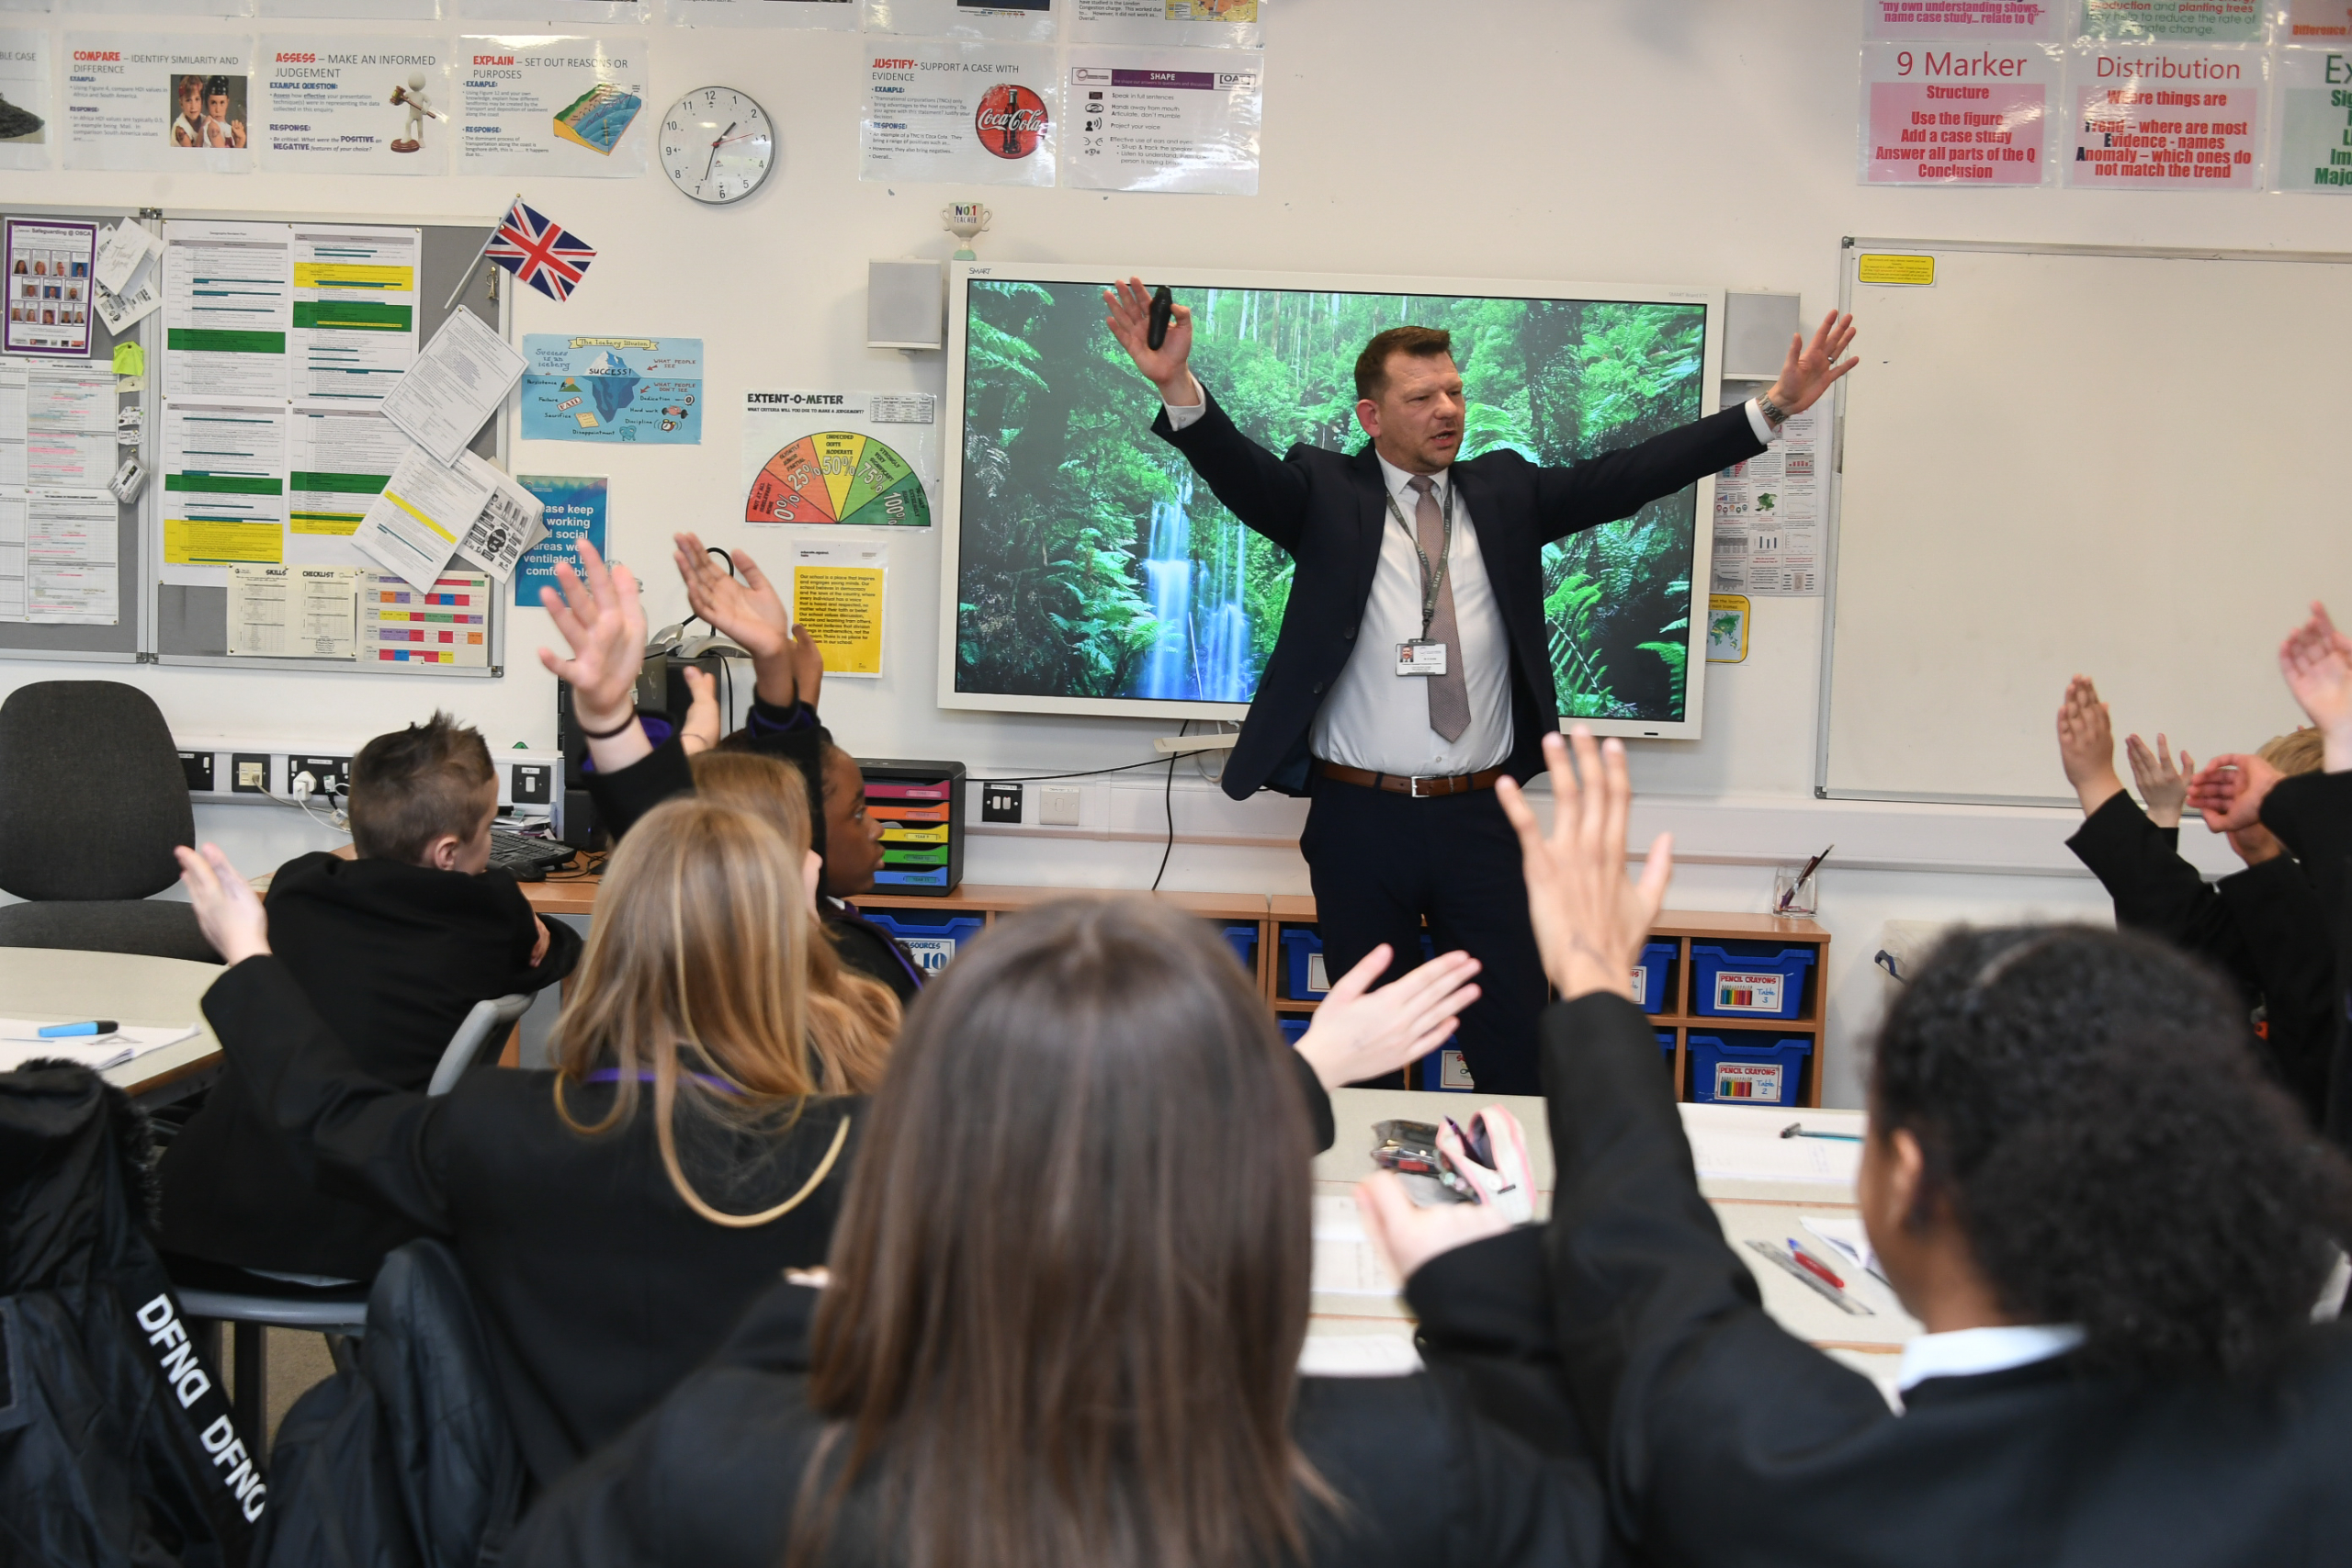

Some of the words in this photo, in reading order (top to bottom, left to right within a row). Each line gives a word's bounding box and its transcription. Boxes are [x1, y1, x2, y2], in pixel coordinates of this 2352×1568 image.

[1901, 2, 1923, 11] own
[1926, 1, 2002, 13] understanding
[1884, 14, 1914, 22] name
[1917, 14, 1941, 22] case
[1982, 13, 2012, 23] relate
[2015, 14, 2025, 23] to
[2155, 13, 2194, 22] reduce
[2198, 13, 2215, 23] the
[2218, 14, 2242, 24] rate
[2169, 24, 2215, 36] change.
[16, 52, 37, 62] CASE
[74, 51, 121, 62] COMPARE
[131, 54, 169, 63] IDENTIFY
[171, 55, 217, 64] SIMILARITY
[220, 56, 239, 65] AND
[276, 52, 316, 63] ASSESS
[328, 54, 358, 64] MAKE
[361, 54, 377, 65] AN
[379, 55, 436, 65] INFORMED
[473, 55, 514, 66] EXPLAIN
[525, 58, 542, 67] SET
[544, 58, 564, 67] OUT
[567, 59, 612, 68] REASONS
[614, 59, 628, 68] OR
[74, 64, 125, 73] DIFFERENCE
[920, 62, 961, 73] SUPPORT
[962, 63, 969, 72] A
[971, 63, 993, 73] CASE
[996, 64, 1019, 73] WITH
[1897, 51, 1913, 76] 9
[1925, 51, 2027, 76] Marker
[2097, 56, 2241, 79] Distribution
[275, 67, 341, 78] JUDGEMENT
[473, 70, 522, 79] PURPOSES
[872, 72, 915, 82] EVIDENCE
[1150, 73, 1176, 81] SHAPE
[302, 82, 338, 90] QUESTION:
[705, 90, 716, 100] 12
[1927, 85, 1990, 99] Structure
[732, 95, 737, 104] 1
[2156, 91, 2200, 107] things
[2203, 93, 2227, 106] are
[683, 101, 693, 110] 11
[751, 108, 757, 118] 2
[978, 107, 1044, 131] Coca-Cola
[1911, 111, 1937, 125] Use
[1939, 112, 1961, 125] the
[1963, 112, 2004, 127] figure
[667, 121, 677, 130] 10
[2139, 120, 2183, 135] where
[2186, 122, 2208, 135] are
[2211, 122, 2247, 135] most
[340, 135, 375, 143] POSITIVE
[1901, 129, 1927, 142] Add
[1929, 131, 1938, 142] a
[1940, 131, 1973, 143] case
[1975, 130, 2012, 144] study
[2104, 133, 2166, 148] Evidence
[2177, 137, 2224, 149] names
[666, 146, 672, 155] 9
[1875, 146, 1926, 160] Answer
[1928, 146, 1946, 160] all
[1949, 147, 1984, 162] parts
[1986, 147, 2000, 161] of
[2002, 148, 2024, 161] the
[2027, 147, 2036, 163] Q
[2076, 147, 2137, 163] Anomaly
[2151, 149, 2193, 164] which
[2197, 152, 2230, 164] ones
[2233, 150, 2251, 164] do
[758, 160, 764, 169] 4
[674, 169, 681, 179] 8
[1918, 164, 1993, 178] Conclusion
[2095, 164, 2118, 176] not
[2120, 164, 2165, 177] match
[2168, 164, 2189, 177] the
[2193, 164, 2231, 178] trend
[742, 179, 749, 188] 5
[695, 186, 700, 195] 7
[719, 189, 726, 199] 6
[32, 228, 67, 236] Safeguarding
[560, 399, 579, 410] FAIL
[747, 393, 843, 405] EXTENT-O-METER
[821, 456, 856, 476] 50%
[787, 460, 821, 491] 25%
[857, 461, 887, 493] 75%
[567, 504, 594, 516] keep
[773, 494, 800, 521] 0%
[883, 491, 906, 525] 100%
[547, 517, 591, 529] working
[556, 530, 588, 539] social
[533, 543, 562, 551] areas
[524, 554, 576, 564] ventilated
[922, 952, 947, 970] 10
[1720, 975, 1744, 983] PENCIL
[1746, 976, 1777, 985] CRAYONS
[1761, 996, 1769, 1004] 3
[1720, 1066, 1743, 1075] PENCIL
[1745, 1067, 1776, 1077] CRAYONS
[1756, 1079, 1775, 1088] Table
[136, 1292, 211, 1409] DFND
